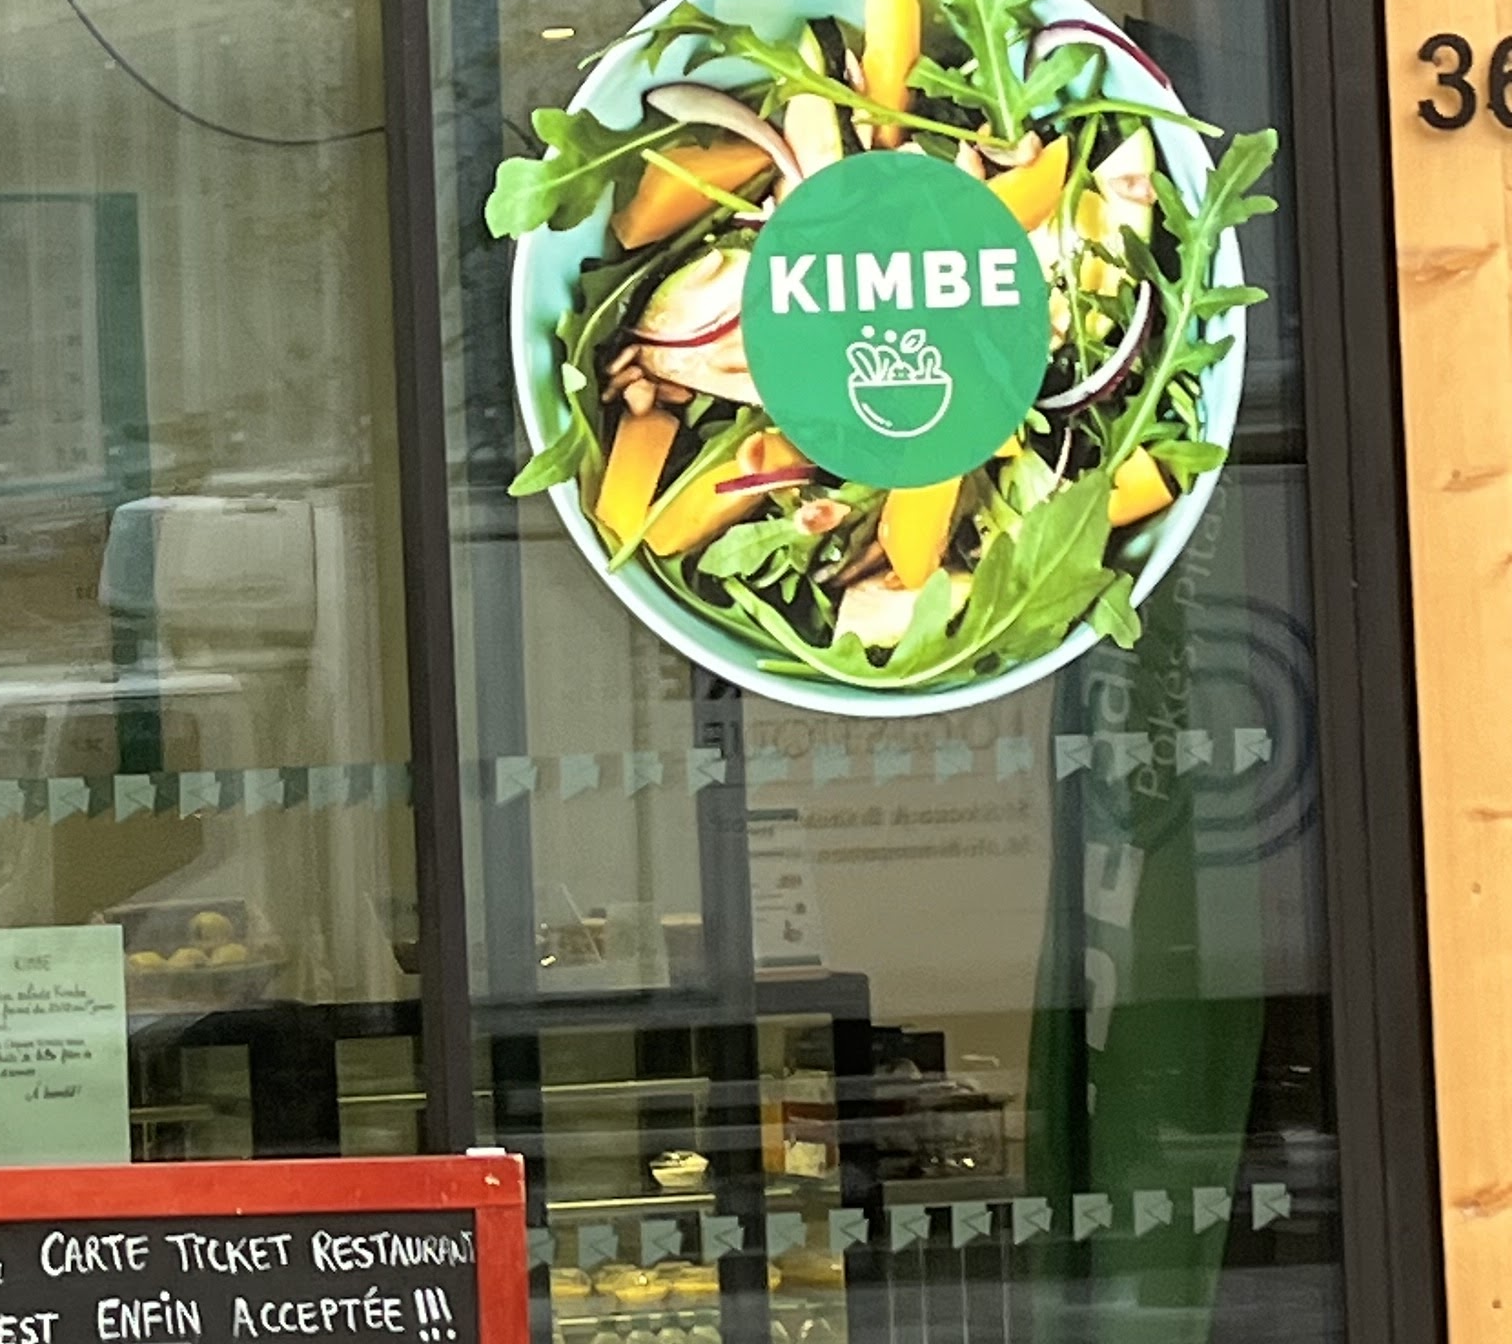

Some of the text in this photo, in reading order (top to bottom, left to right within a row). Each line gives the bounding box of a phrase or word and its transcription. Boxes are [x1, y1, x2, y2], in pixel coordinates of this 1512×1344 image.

[768, 247, 1022, 315] KIMBE
[40, 1231, 150, 1277] CARTE
[311, 1230, 477, 1271] RESTAURANT
[231, 1286, 406, 1340] ACCEPTÉE
